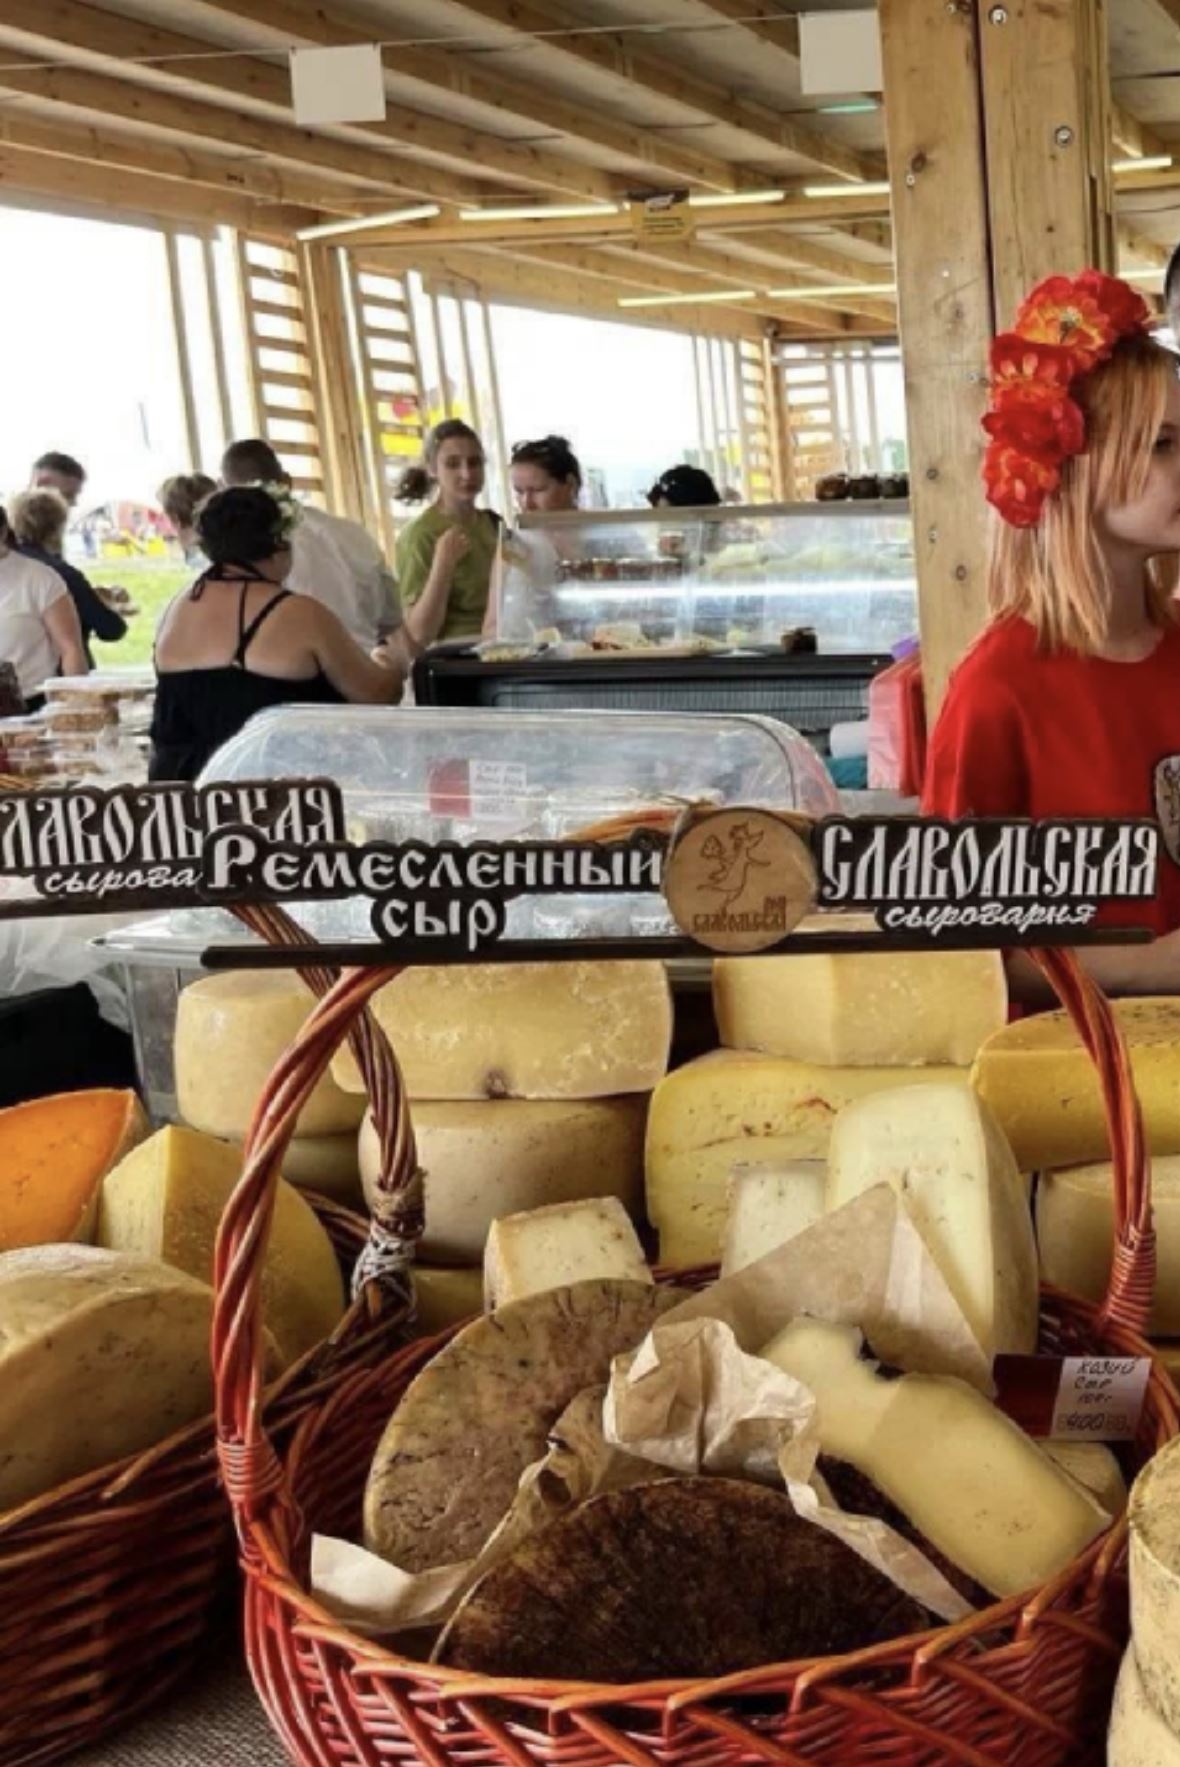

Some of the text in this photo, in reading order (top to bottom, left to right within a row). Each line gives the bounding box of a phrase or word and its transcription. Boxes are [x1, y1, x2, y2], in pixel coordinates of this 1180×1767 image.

[822, 826, 1157, 899] СЛАВОЛЬСКАЯ
[44, 865, 202, 897] сырова
[884, 902, 1097, 936] сыроварня
